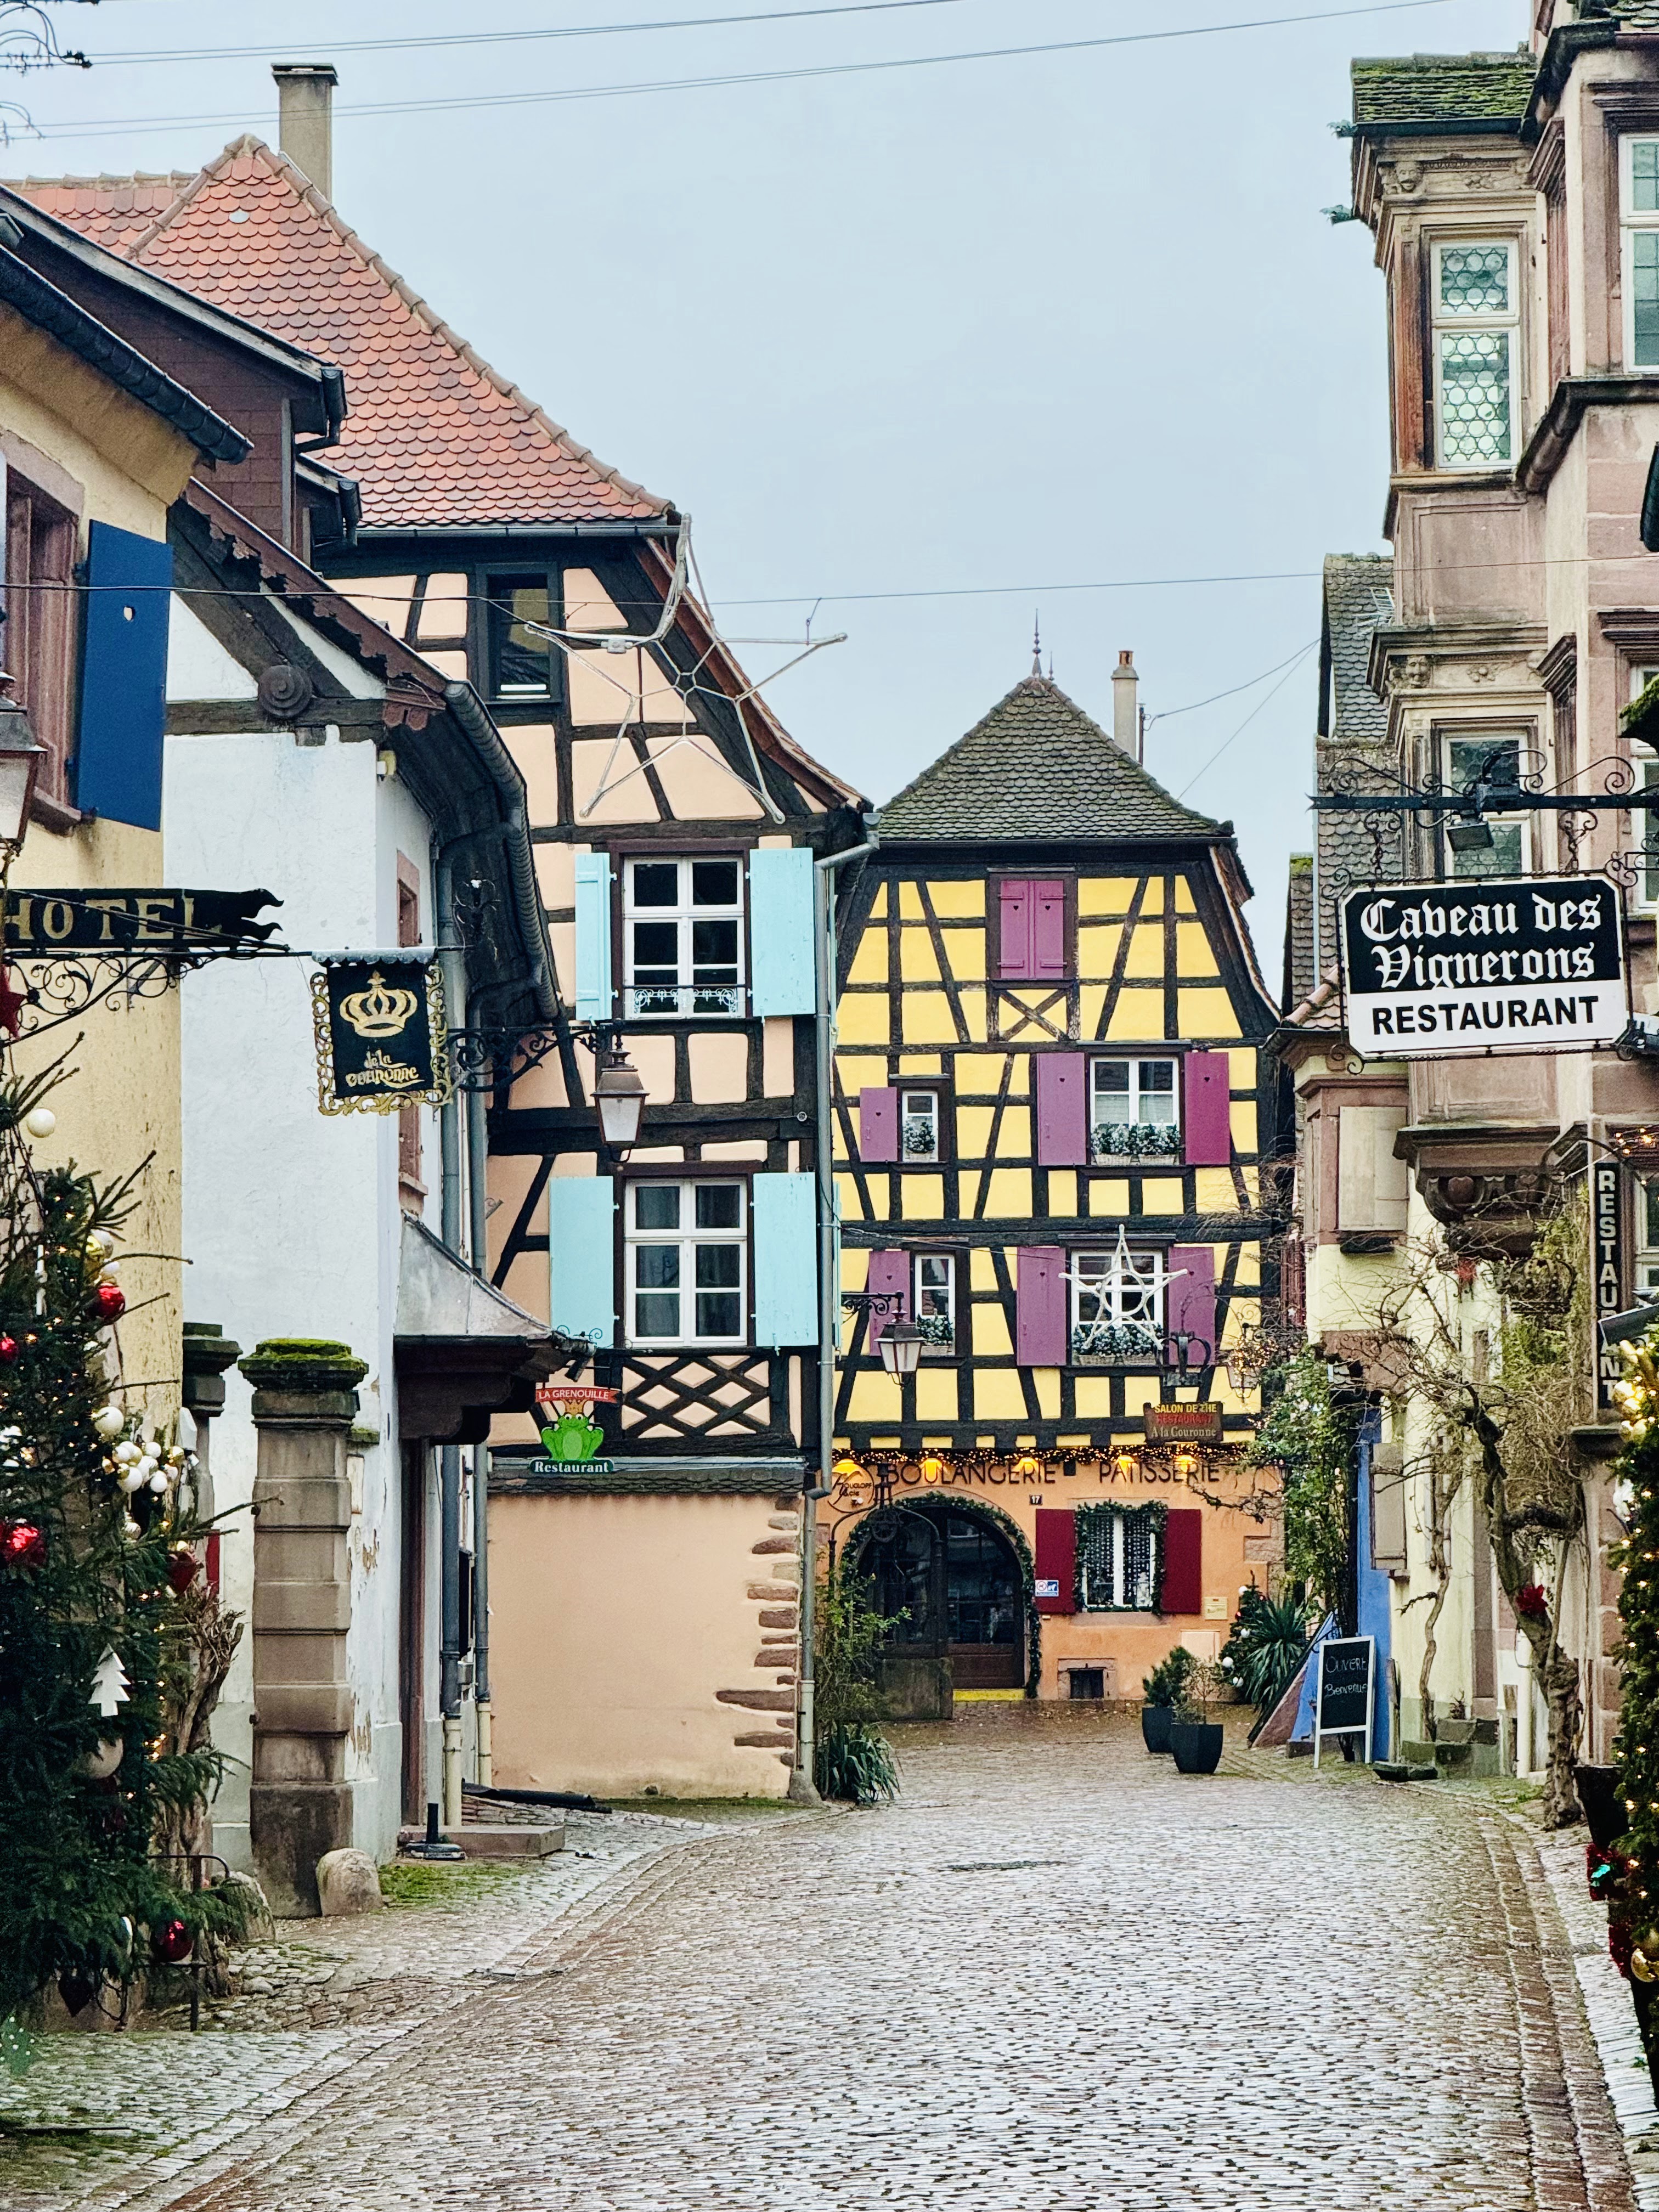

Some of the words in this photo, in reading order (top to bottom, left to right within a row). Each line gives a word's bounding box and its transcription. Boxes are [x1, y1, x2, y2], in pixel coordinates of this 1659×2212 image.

[1360, 898, 1519, 941] Caveau
[1532, 893, 1601, 932] des
[1372, 941, 1595, 990] Vignerons
[1372, 996, 1599, 1035] RESTAURANT
[1599, 1170, 1620, 1401] RESTAUNT
[539, 1391, 550, 1400] LA
[552, 1390, 609, 1400] GRENOUILLE
[1155, 1404, 1183, 1413] SALON
[1186, 1404, 1198, 1413] DE
[534, 1462, 608, 1472] Restaurant
[883, 1461, 1056, 1484] BOULANGERIE
[1031, 1496, 1040, 1504] 17
[1324, 1683, 1367, 1697] Bienvenue
